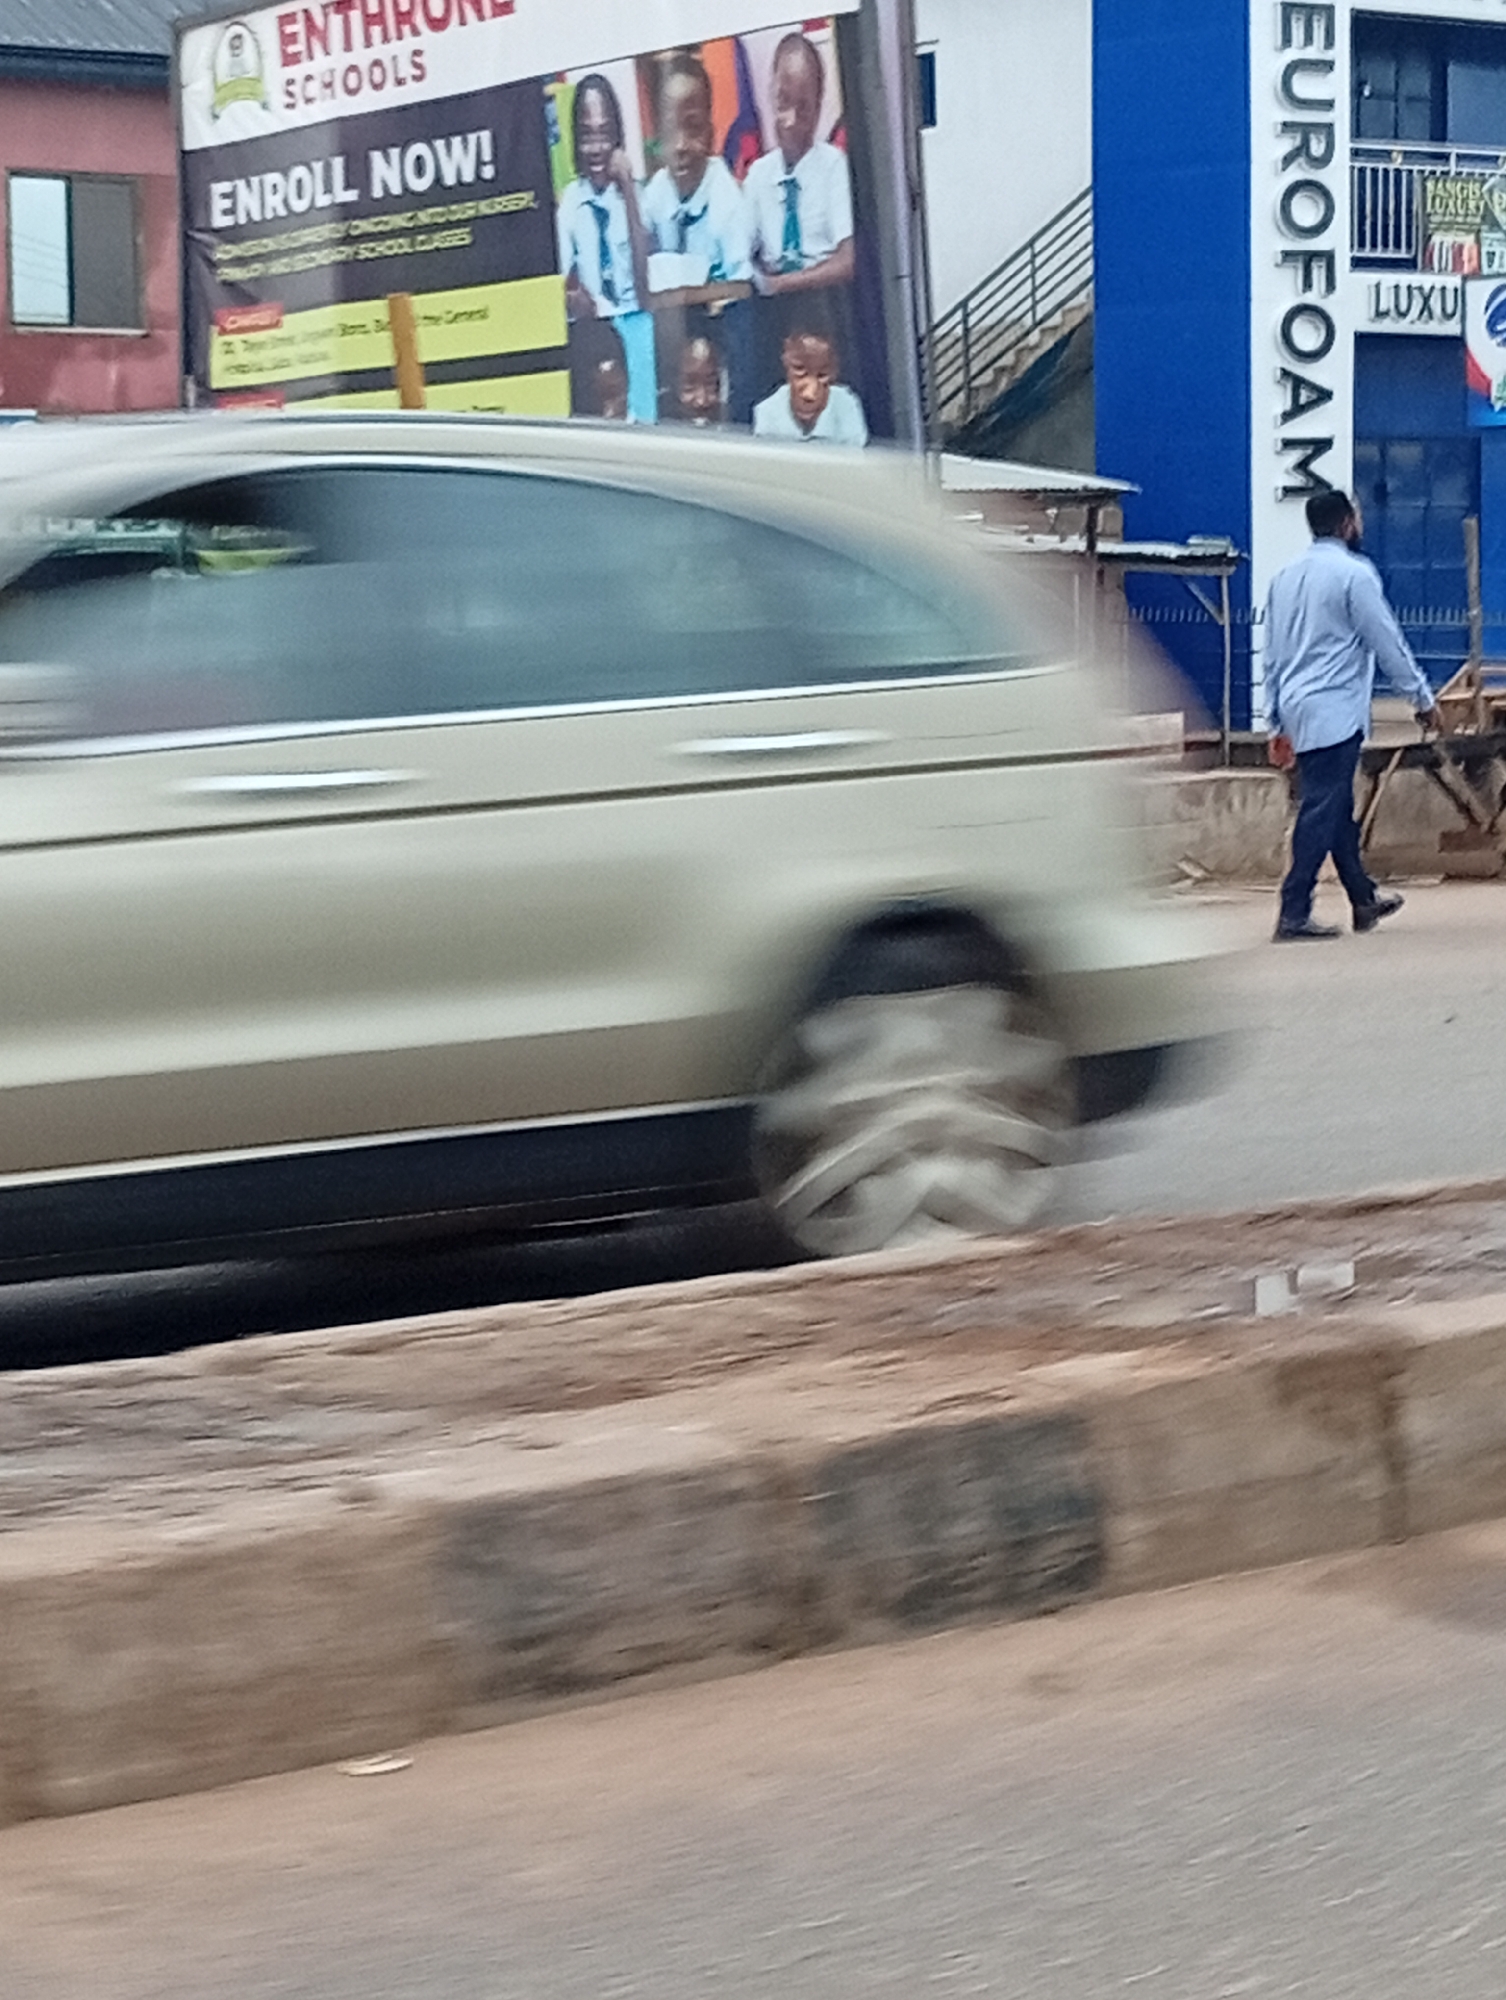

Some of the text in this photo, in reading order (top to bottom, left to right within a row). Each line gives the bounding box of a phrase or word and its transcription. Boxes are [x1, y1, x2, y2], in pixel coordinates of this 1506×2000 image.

[284, 48, 427, 110] SCHOOLS
[209, 129, 496, 229] ENROLL NOW!
[1275, 2, 1336, 502] EUROFOAM
[1370, 281, 1459, 321] LUXU
